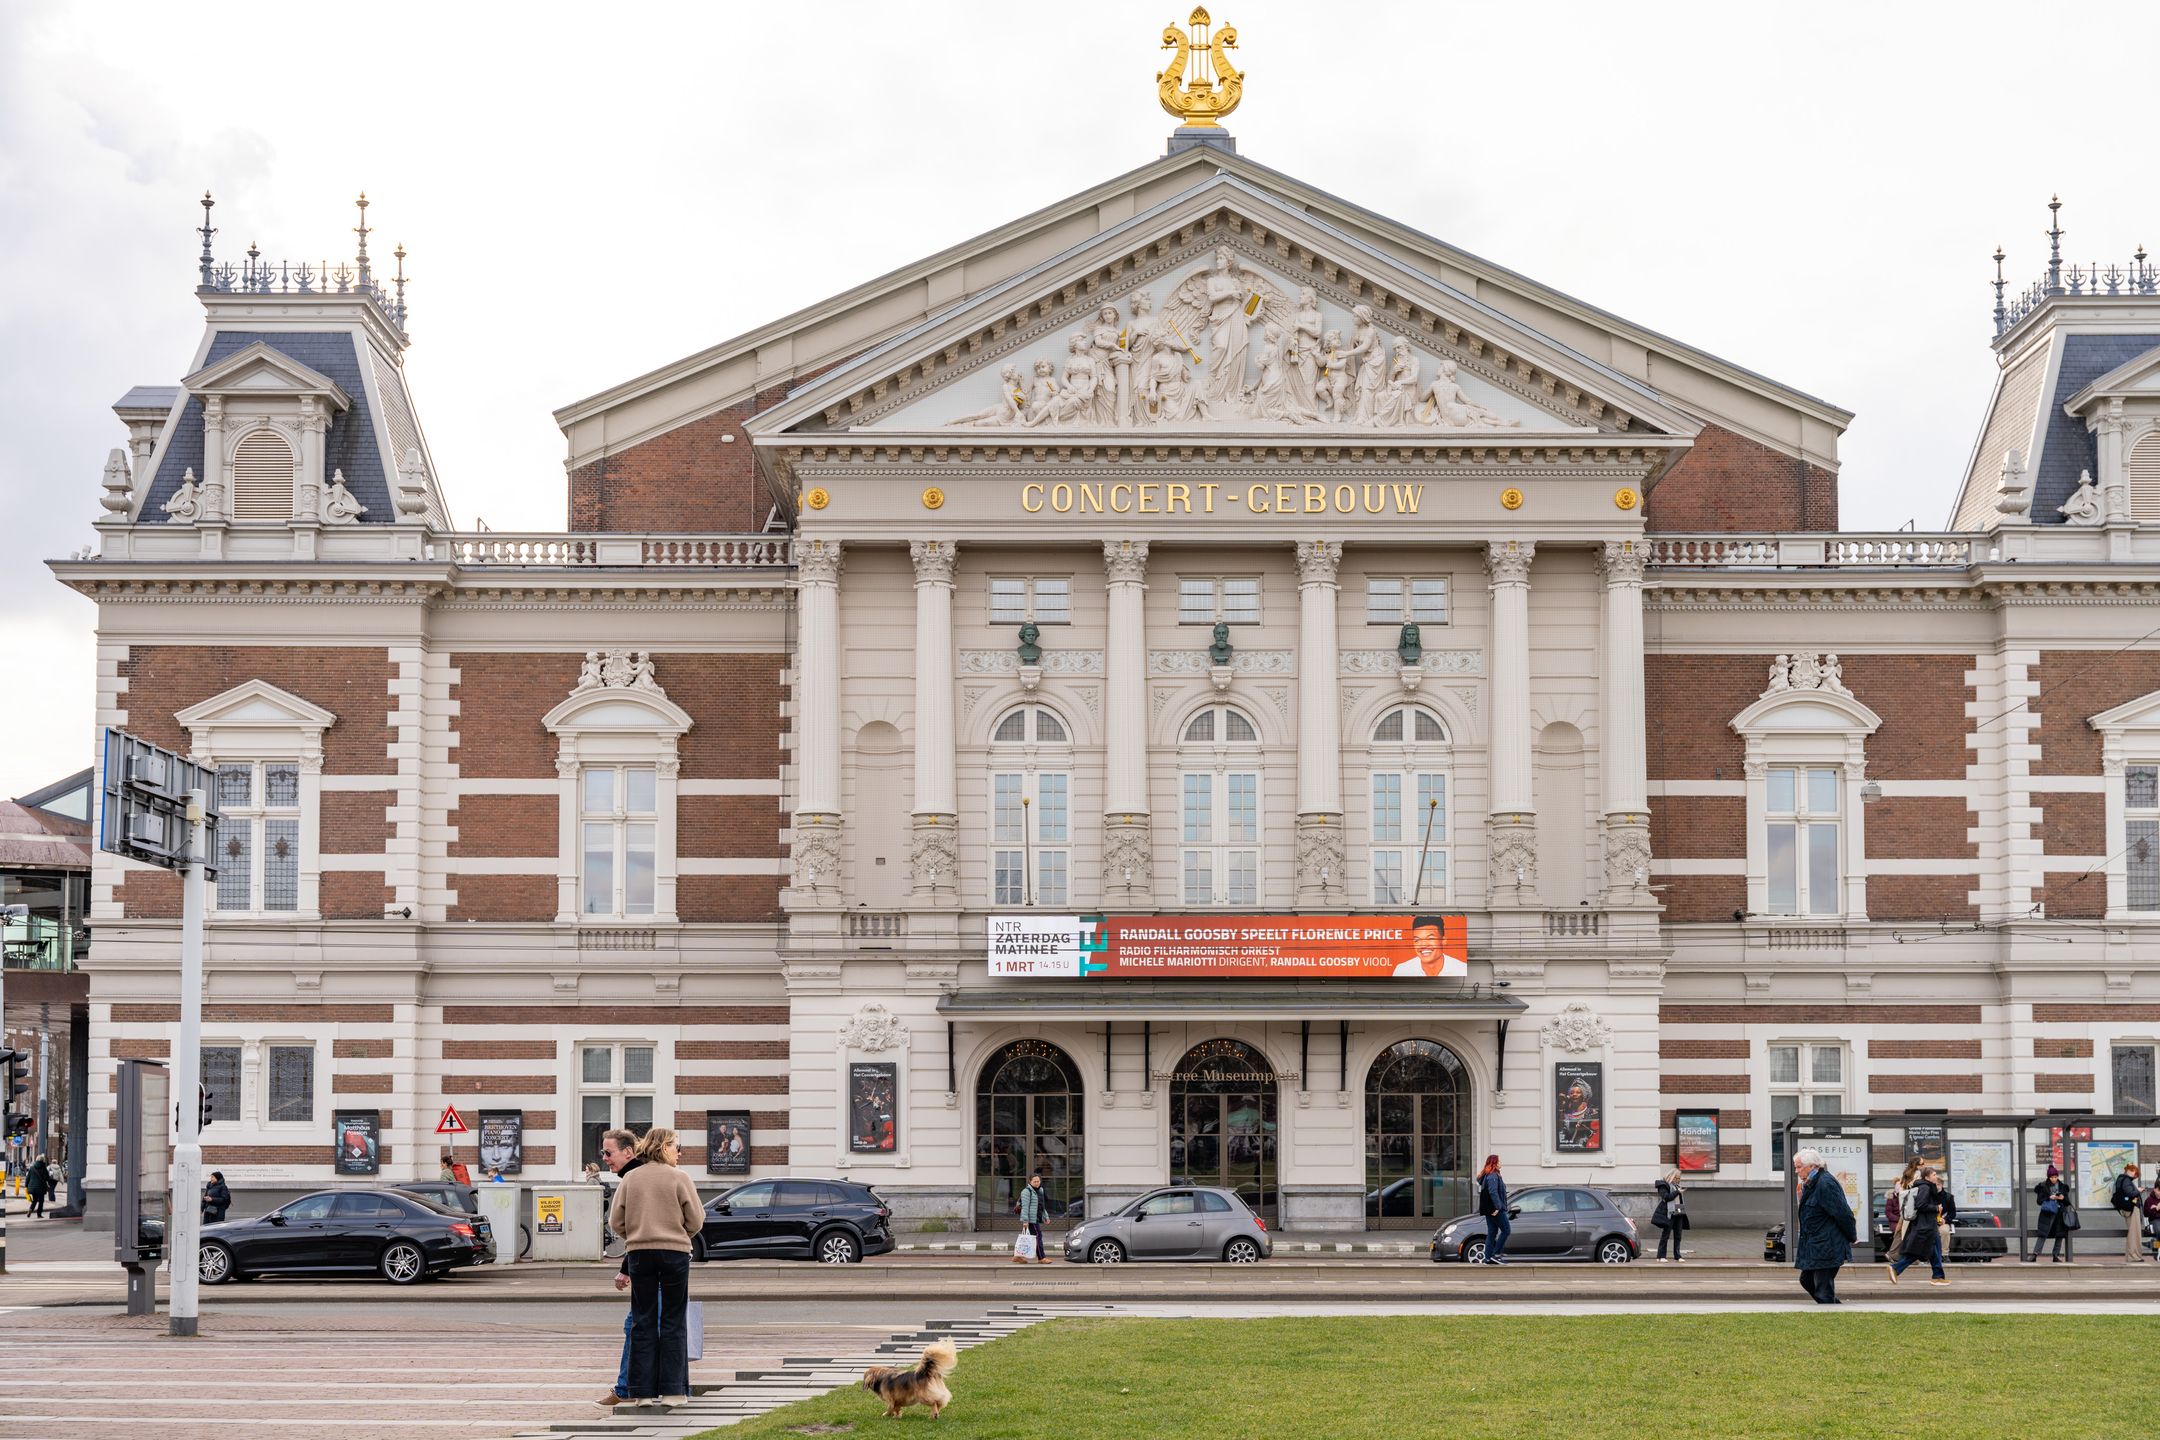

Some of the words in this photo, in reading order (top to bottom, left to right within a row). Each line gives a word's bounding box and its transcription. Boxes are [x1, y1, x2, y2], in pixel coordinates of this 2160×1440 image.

[1021, 483, 1424, 514] CONCERT-GEBOUW
[995, 922, 1022, 932] NTR
[995, 933, 1071, 944] ZATERDAG
[1120, 929, 1181, 940] RANDALL
[1184, 929, 1238, 940] GOOSBY
[1241, 929, 1288, 940] SPEELT
[1292, 929, 1361, 940] FLORENCE
[1364, 929, 1402, 940] PRICE
[995, 944, 1059, 955] MATINEE
[1120, 946, 1151, 956] RADIO
[1154, 946, 1238, 956] FILHARMONISCH
[1241, 946, 1281, 956] ORKEST
[995, 962, 1001, 972] 1
[1006, 962, 1035, 972] MRT
[1039, 961, 1062, 969] 14.15
[1063, 961, 1070, 969] U
[1120, 957, 1165, 967] MICHELE
[1167, 957, 1217, 967] MARIOTTI
[1219, 957, 1268, 968] DIRIGENT,
[1270, 957, 1317, 967] RANDALL
[1319, 957, 1360, 967] GOOSBY
[1362, 957, 1393, 967] VIOOL
